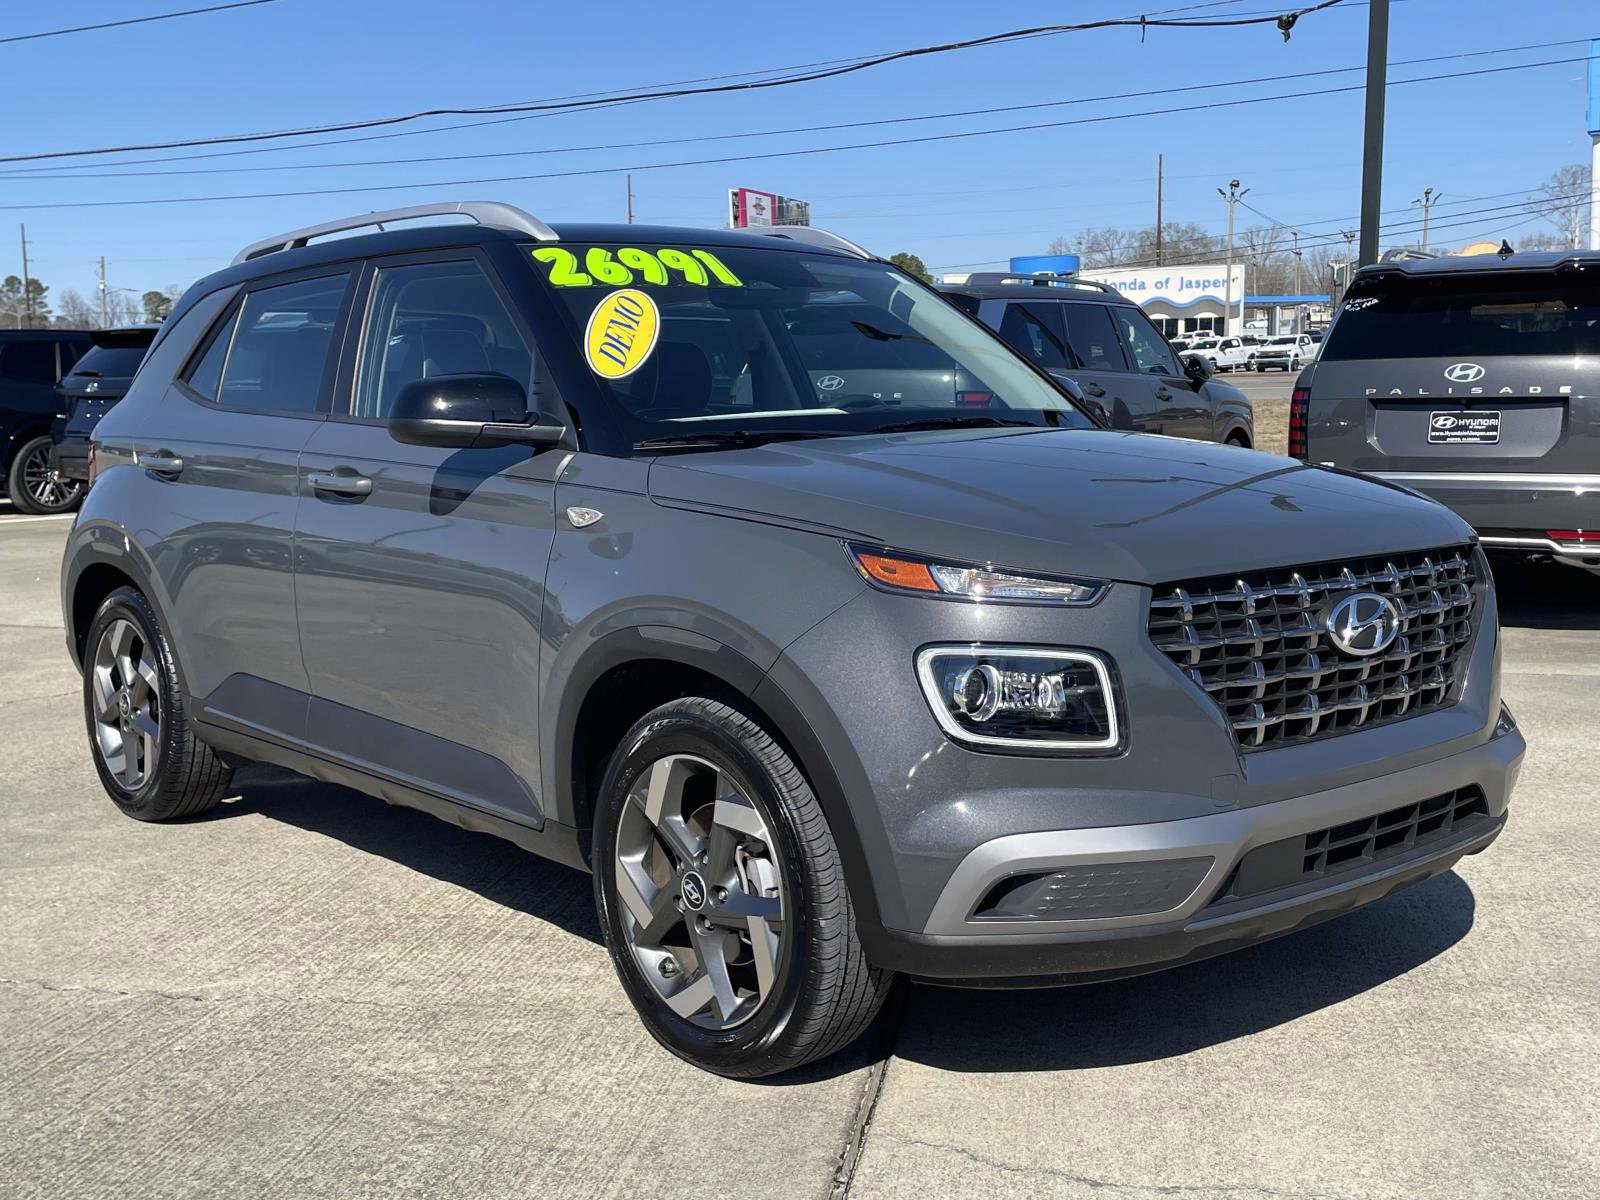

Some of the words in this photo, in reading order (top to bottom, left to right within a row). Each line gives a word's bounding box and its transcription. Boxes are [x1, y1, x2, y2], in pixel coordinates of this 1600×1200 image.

[532, 247, 744, 287] 26991
[1154, 277, 1171, 290] of
[1178, 276, 1228, 291] Jasper
[598, 295, 645, 369] DEMO
[1365, 386, 1572, 395] PALISADE
